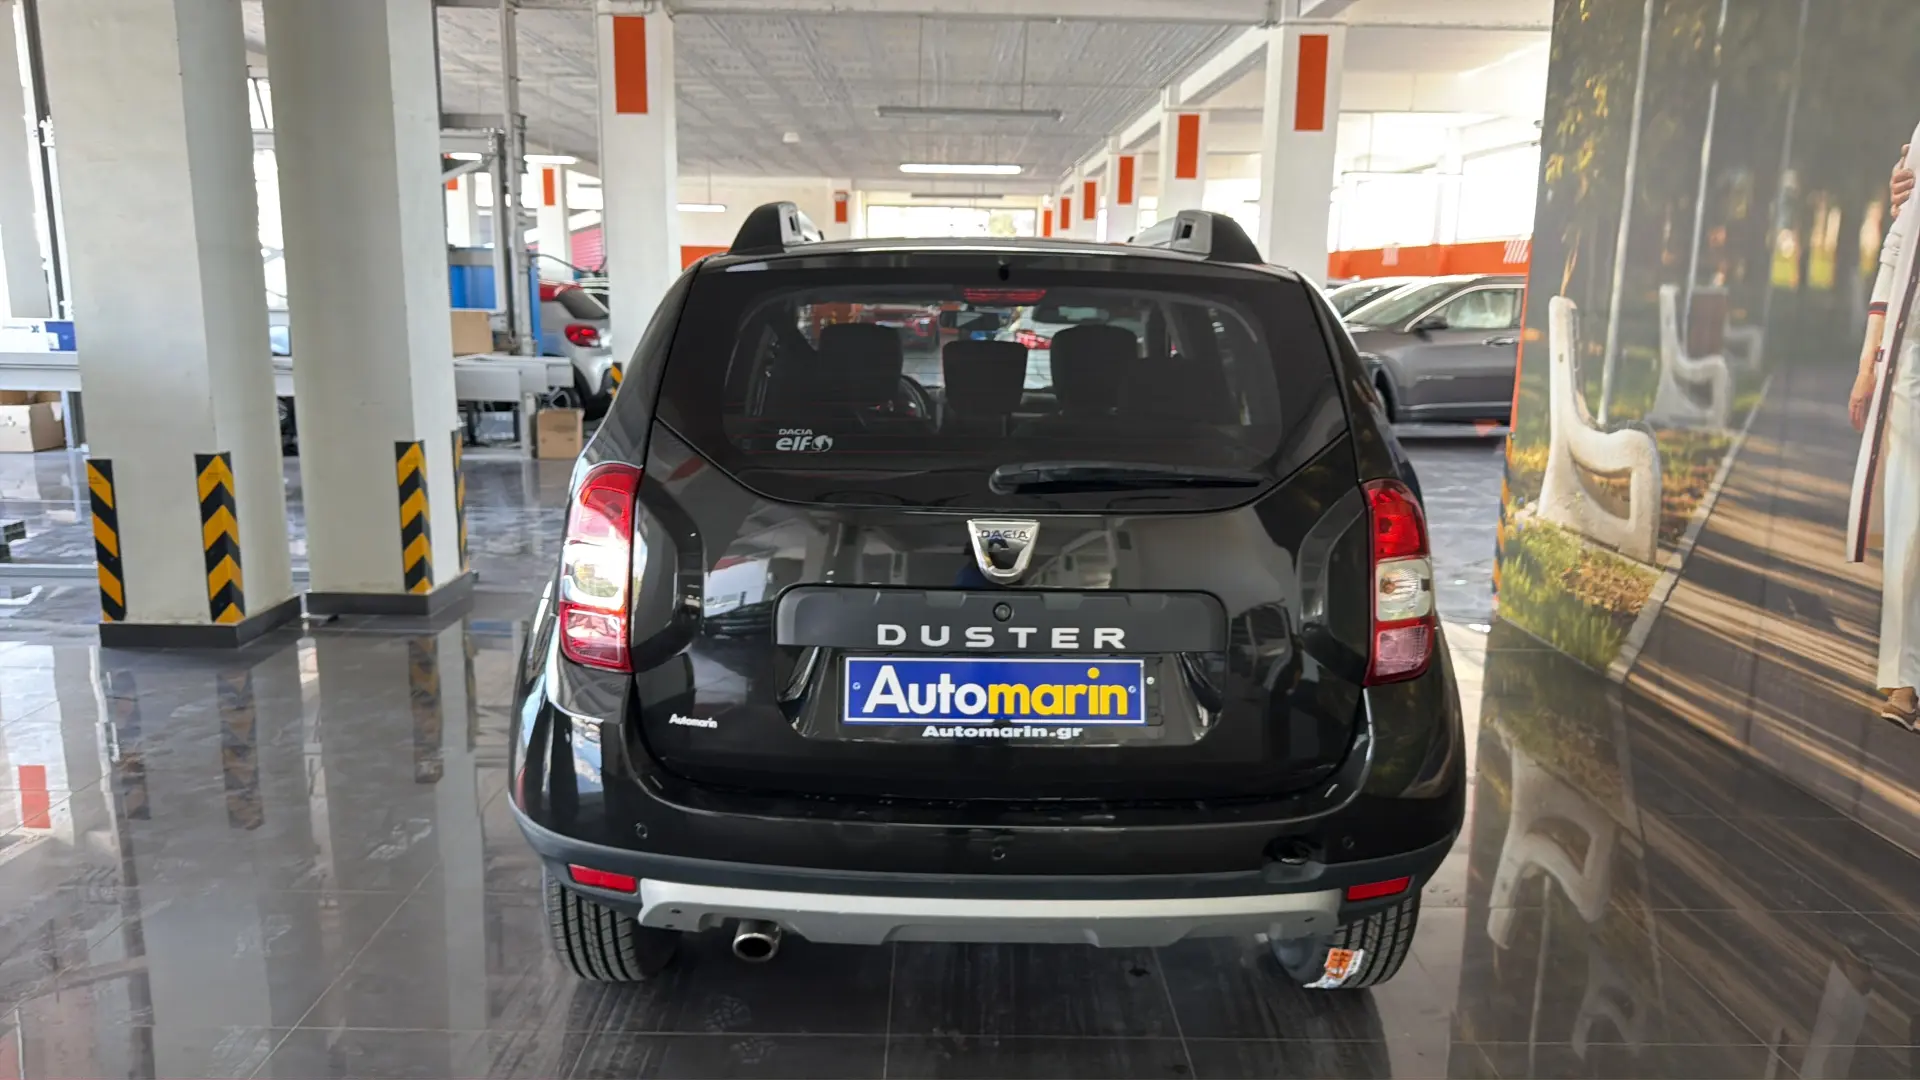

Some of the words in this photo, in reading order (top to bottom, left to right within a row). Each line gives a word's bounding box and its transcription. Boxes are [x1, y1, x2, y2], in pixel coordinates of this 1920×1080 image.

[778, 428, 814, 436] DACIA
[775, 435, 813, 452] elf
[981, 530, 1029, 540] DACIA
[877, 624, 1126, 649] DUSTER
[862, 664, 1128, 716] Automarin
[668, 713, 718, 729] Automarin
[922, 725, 1083, 740] Automarin.gr
